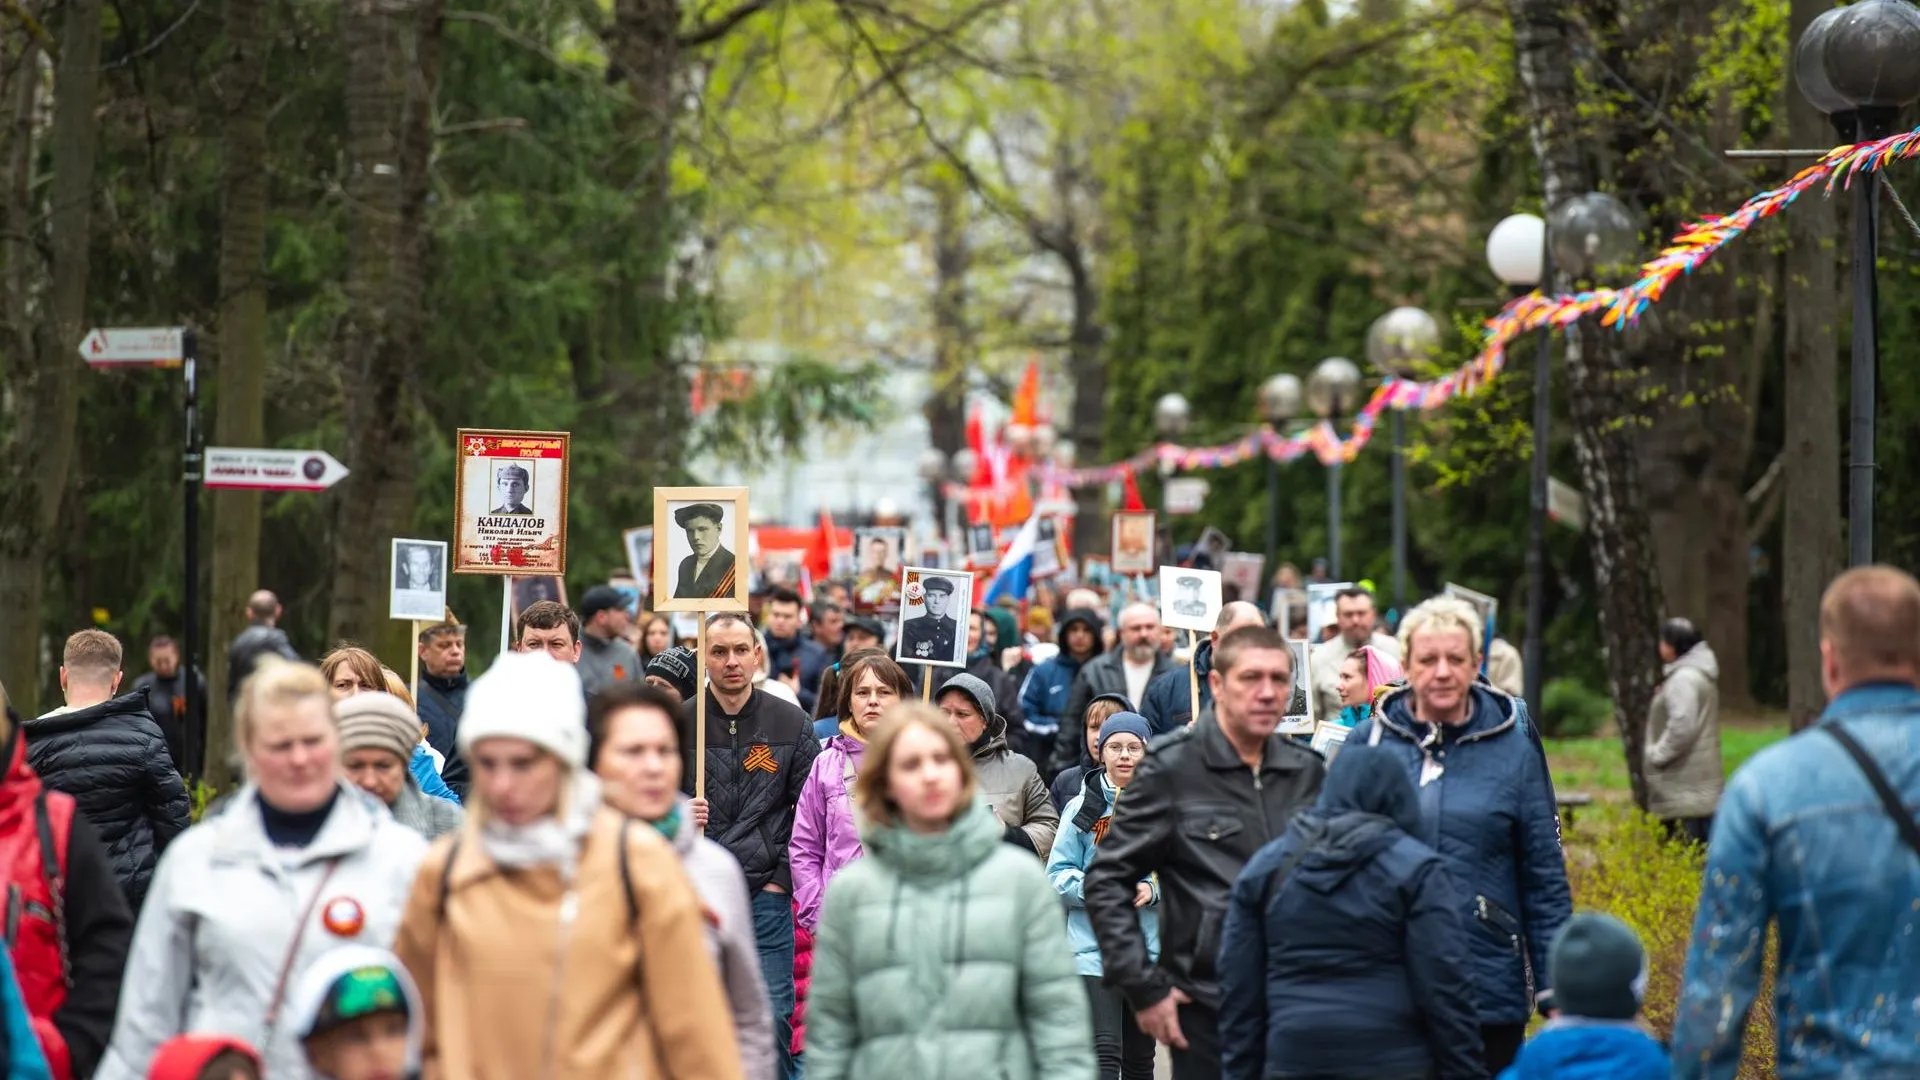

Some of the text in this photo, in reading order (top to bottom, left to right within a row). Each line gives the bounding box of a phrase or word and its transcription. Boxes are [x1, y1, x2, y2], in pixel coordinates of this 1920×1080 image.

[477, 517, 545, 529] КАНДАЛОВ
[477, 527, 543, 536] Николай Ильич
